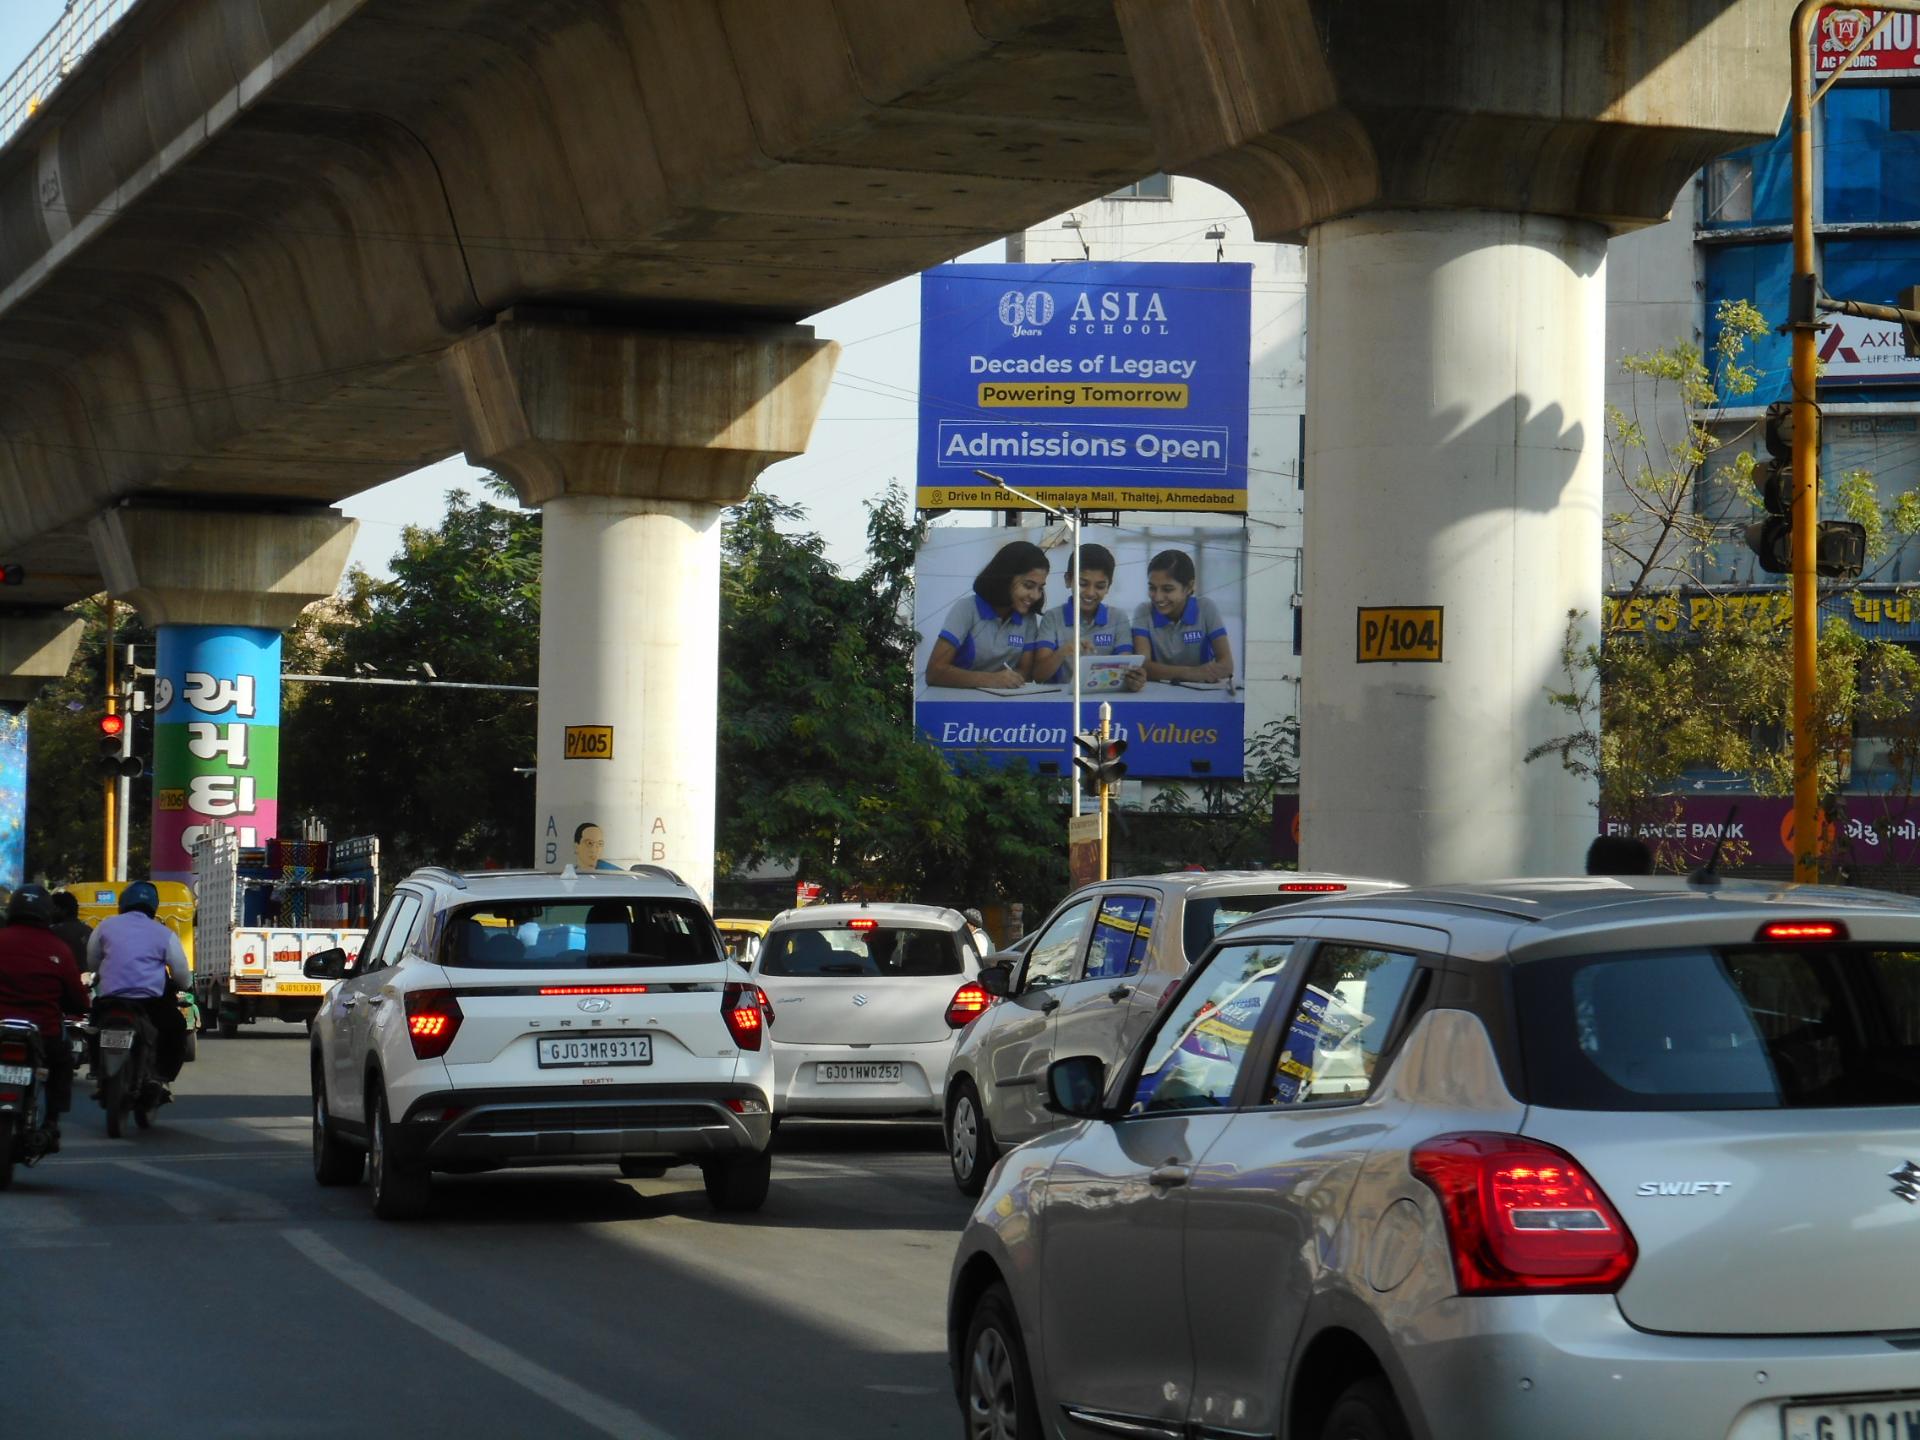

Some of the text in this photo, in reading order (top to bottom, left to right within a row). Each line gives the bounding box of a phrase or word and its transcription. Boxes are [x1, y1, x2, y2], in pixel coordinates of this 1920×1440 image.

[1873, 11, 1920, 50] HO
[1821, 56, 1836, 68] AC
[999, 291, 1055, 326] 60
[1070, 292, 1168, 322] ASIA
[1011, 325, 1042, 338] Years
[1069, 324, 1169, 336] SCHOOL
[1867, 354, 1889, 363] LIFE
[969, 355, 1197, 379] Decades of Legacy
[983, 386, 1182, 404] Powering Tomorrow
[946, 432, 1221, 463] Admissions Open
[948, 491, 978, 501] Drive
[980, 491, 992, 501] In
[1036, 491, 1088, 505] Himalaya
[1091, 492, 1117, 503] Mall,
[1166, 493, 1235, 504] Ahmedabad
[1008, 634, 1024, 645] ASIA
[1094, 633, 1113, 643] ASIA
[1183, 631, 1202, 641] ASIA
[1365, 614, 1438, 656] P/104
[941, 722, 1067, 744] Education
[1136, 722, 1218, 744] Values
[567, 731, 608, 755] P/105
[1692, 822, 1744, 838] BANK
[529, 1018, 659, 1027] CRETA
[551, 1041, 647, 1060] GJ03MR9312
[826, 1066, 899, 1079] GJ01HW0252
[1636, 1181, 1732, 1196] SWIFT
